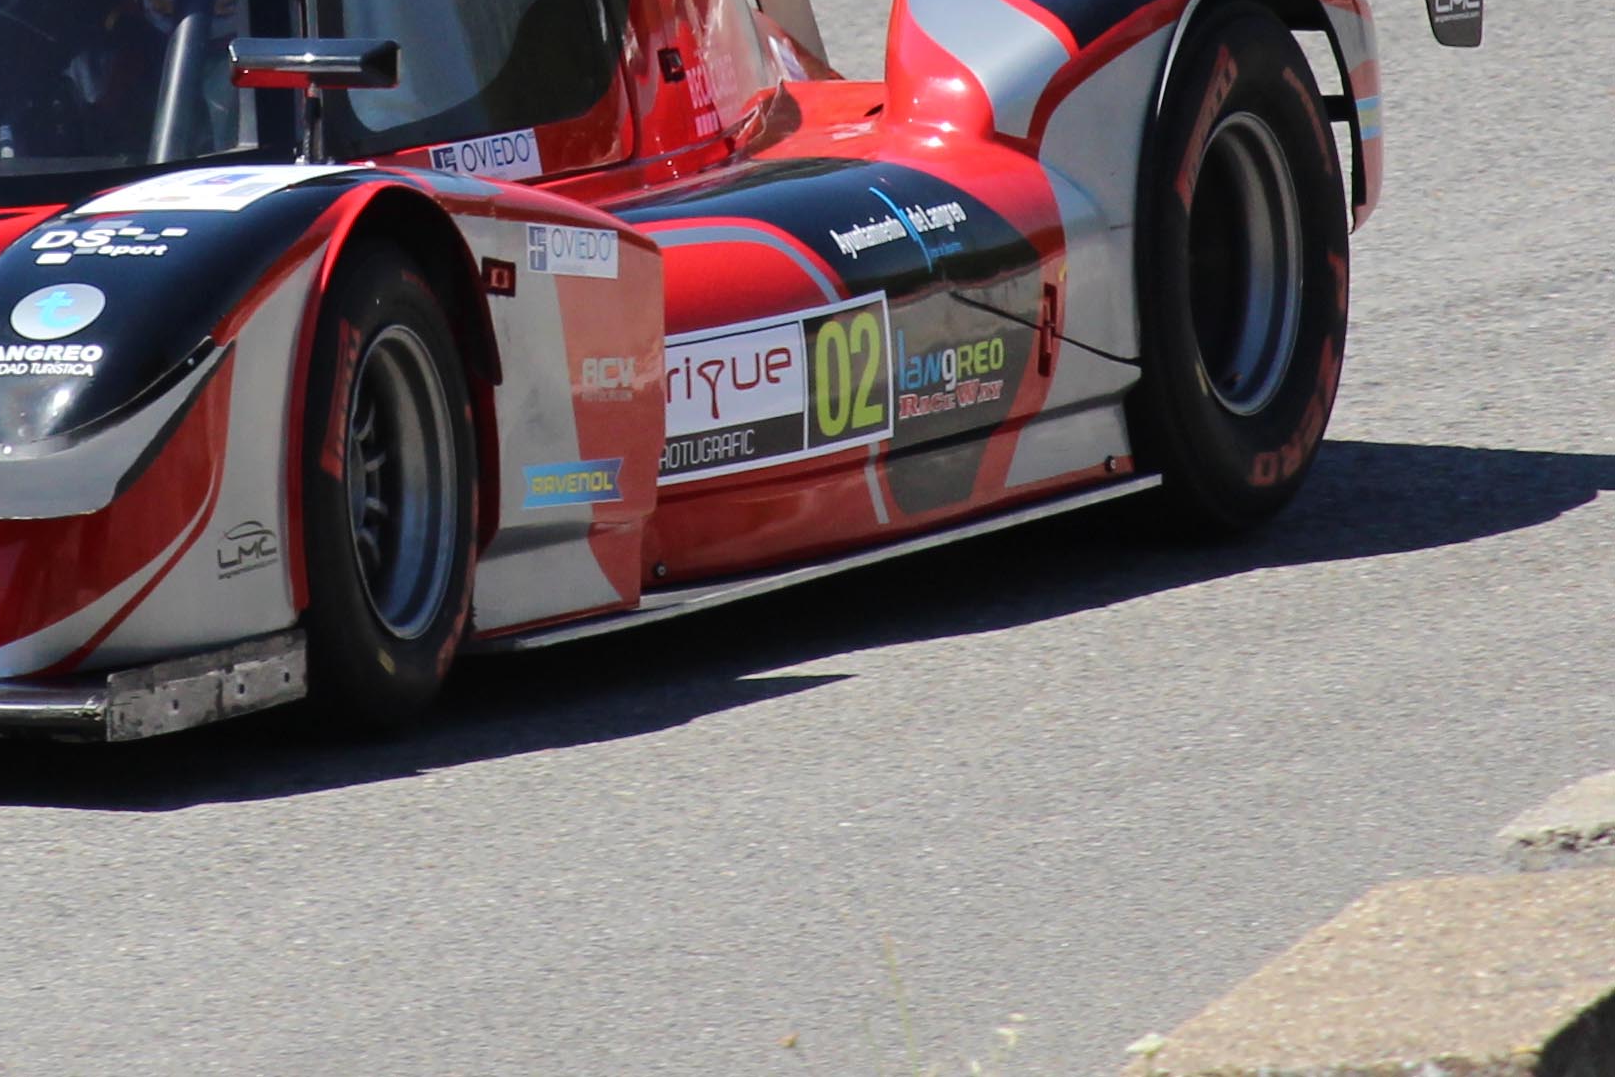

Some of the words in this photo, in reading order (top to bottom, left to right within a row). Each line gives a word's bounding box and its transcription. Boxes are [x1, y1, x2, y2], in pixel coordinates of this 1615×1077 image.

[461, 133, 531, 173] OVIEDO
[31, 228, 112, 250] DS
[97, 243, 168, 257] sport
[551, 227, 612, 262] OVIEDO
[816, 311, 885, 438] 02
[531, 470, 614, 494] RAVENOL
